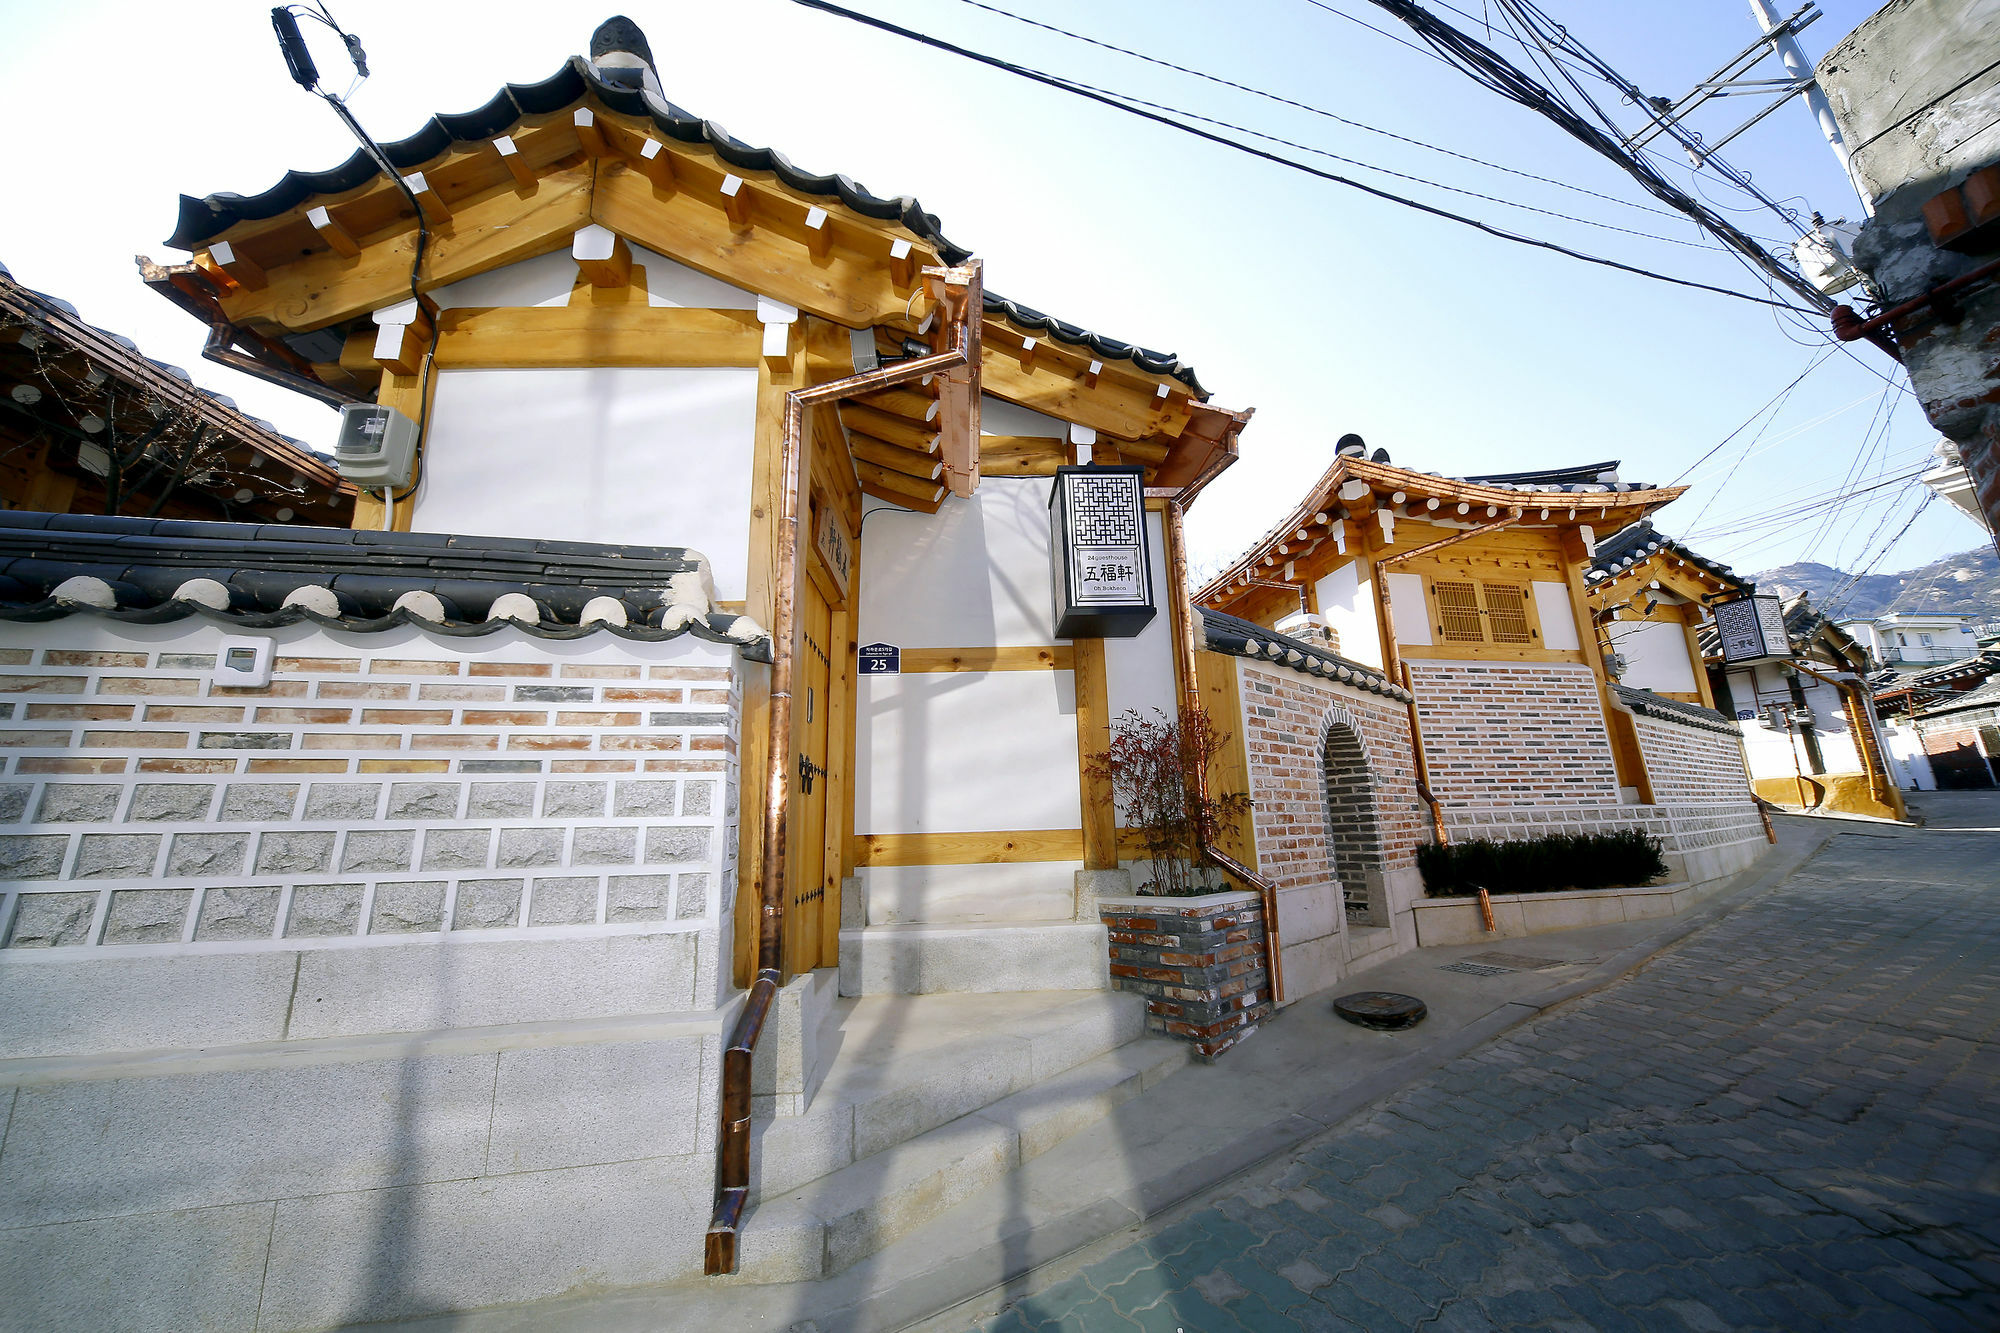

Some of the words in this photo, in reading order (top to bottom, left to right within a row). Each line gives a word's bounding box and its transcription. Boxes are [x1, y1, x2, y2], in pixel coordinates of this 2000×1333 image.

[1083, 563, 1134, 582] 五福軒
[870, 659, 887, 671] 25
